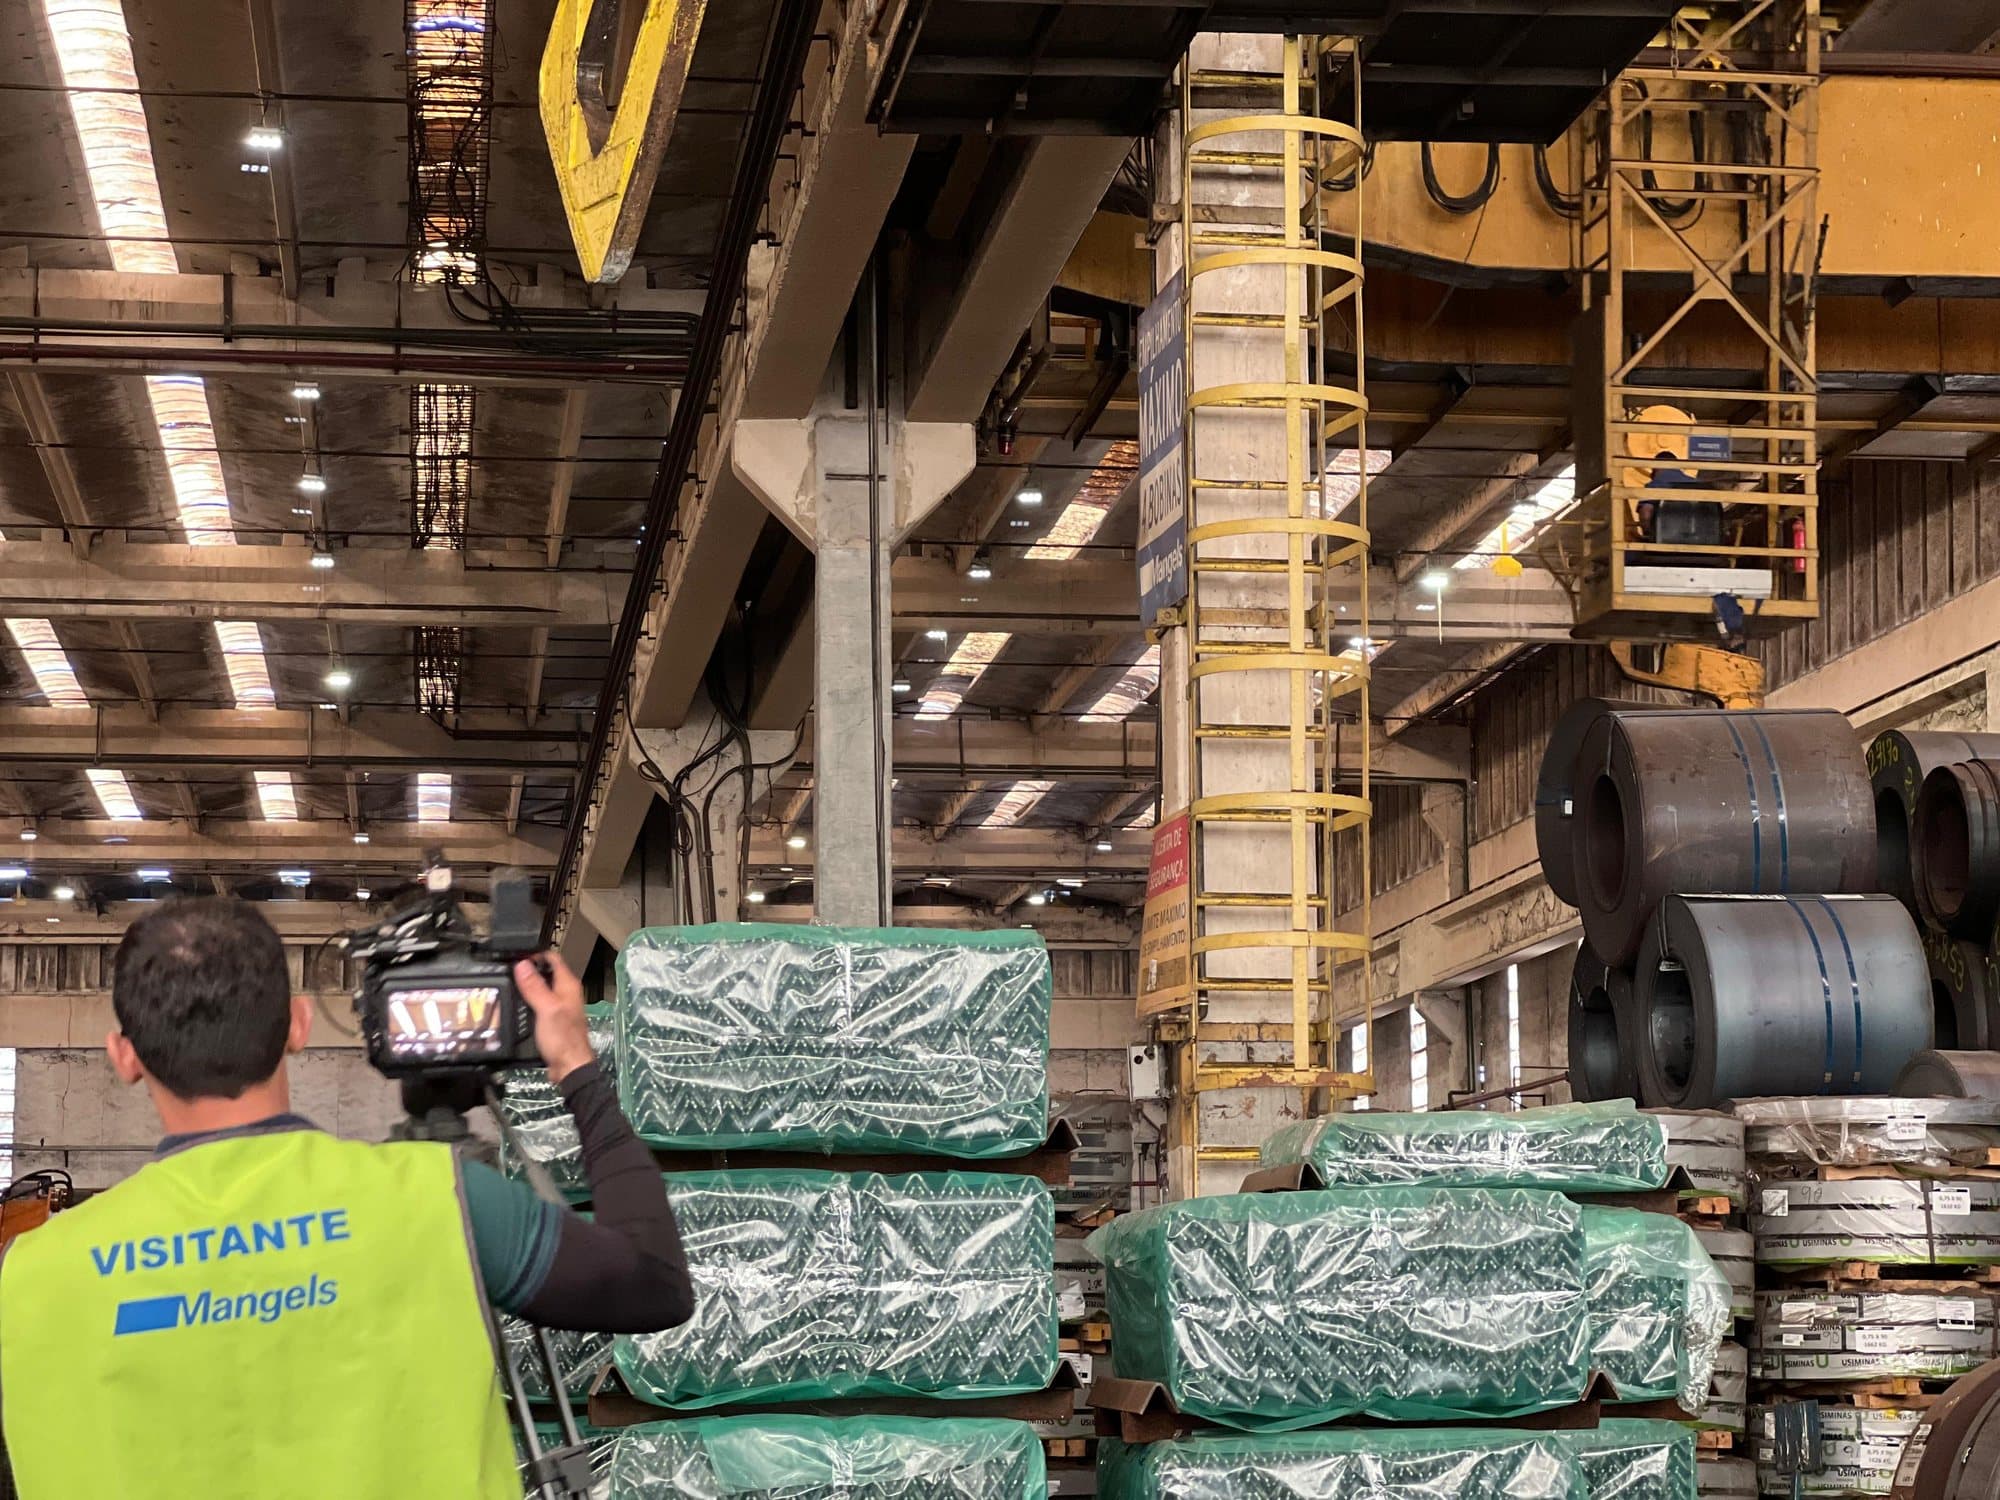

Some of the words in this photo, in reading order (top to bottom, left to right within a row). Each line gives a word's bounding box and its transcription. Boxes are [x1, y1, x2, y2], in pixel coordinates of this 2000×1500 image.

[1139, 297, 1182, 373] EMPILHAMENTO
[1139, 357, 1183, 462] MÁXIMO
[1141, 487, 1148, 532] 4
[1148, 458, 1182, 529] BOBINAS
[1151, 537, 1183, 585] Mangels
[1174, 827, 1182, 849] DE
[1160, 902, 1186, 925] MÁXIMO
[90, 1209, 351, 1277] VISITANTE
[1802, 1238, 1837, 1248] USIMINAS
[178, 1273, 339, 1327] Mangels
[1807, 1323, 1842, 1332] USIMINA
[1783, 1359, 1815, 1368] SIMINAS
[1820, 1411, 1852, 1419] SIMINAS
[1837, 1467, 1877, 1478] USIMINAS
